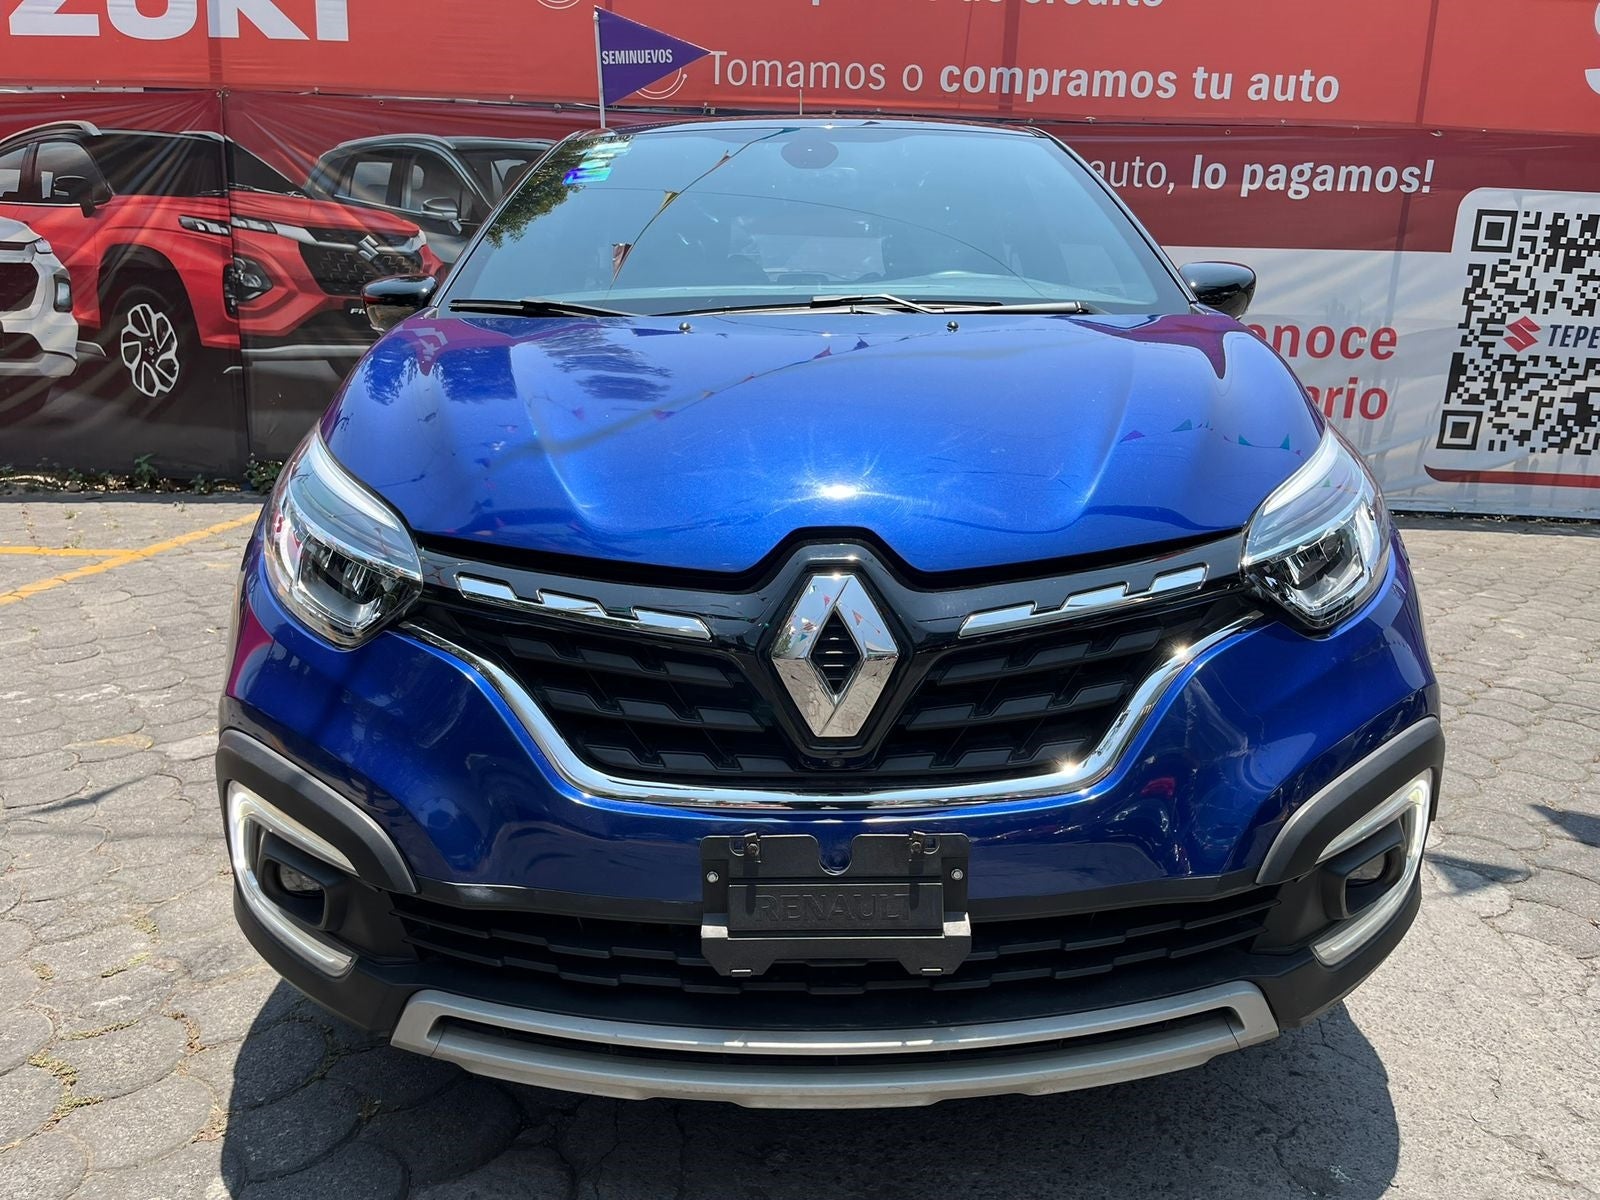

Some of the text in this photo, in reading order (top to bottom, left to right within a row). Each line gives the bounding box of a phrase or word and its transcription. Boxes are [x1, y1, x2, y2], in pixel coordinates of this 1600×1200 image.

[601, 48, 673, 65] SEMINUEVOS
[710, 50, 1340, 103] Tomamos o compramos tu auto
[1191, 154, 1227, 190] lo
[1240, 159, 1435, 200] pagamos!
[1548, 324, 1600, 349] TEPE
[754, 892, 911, 923] RENAULT
